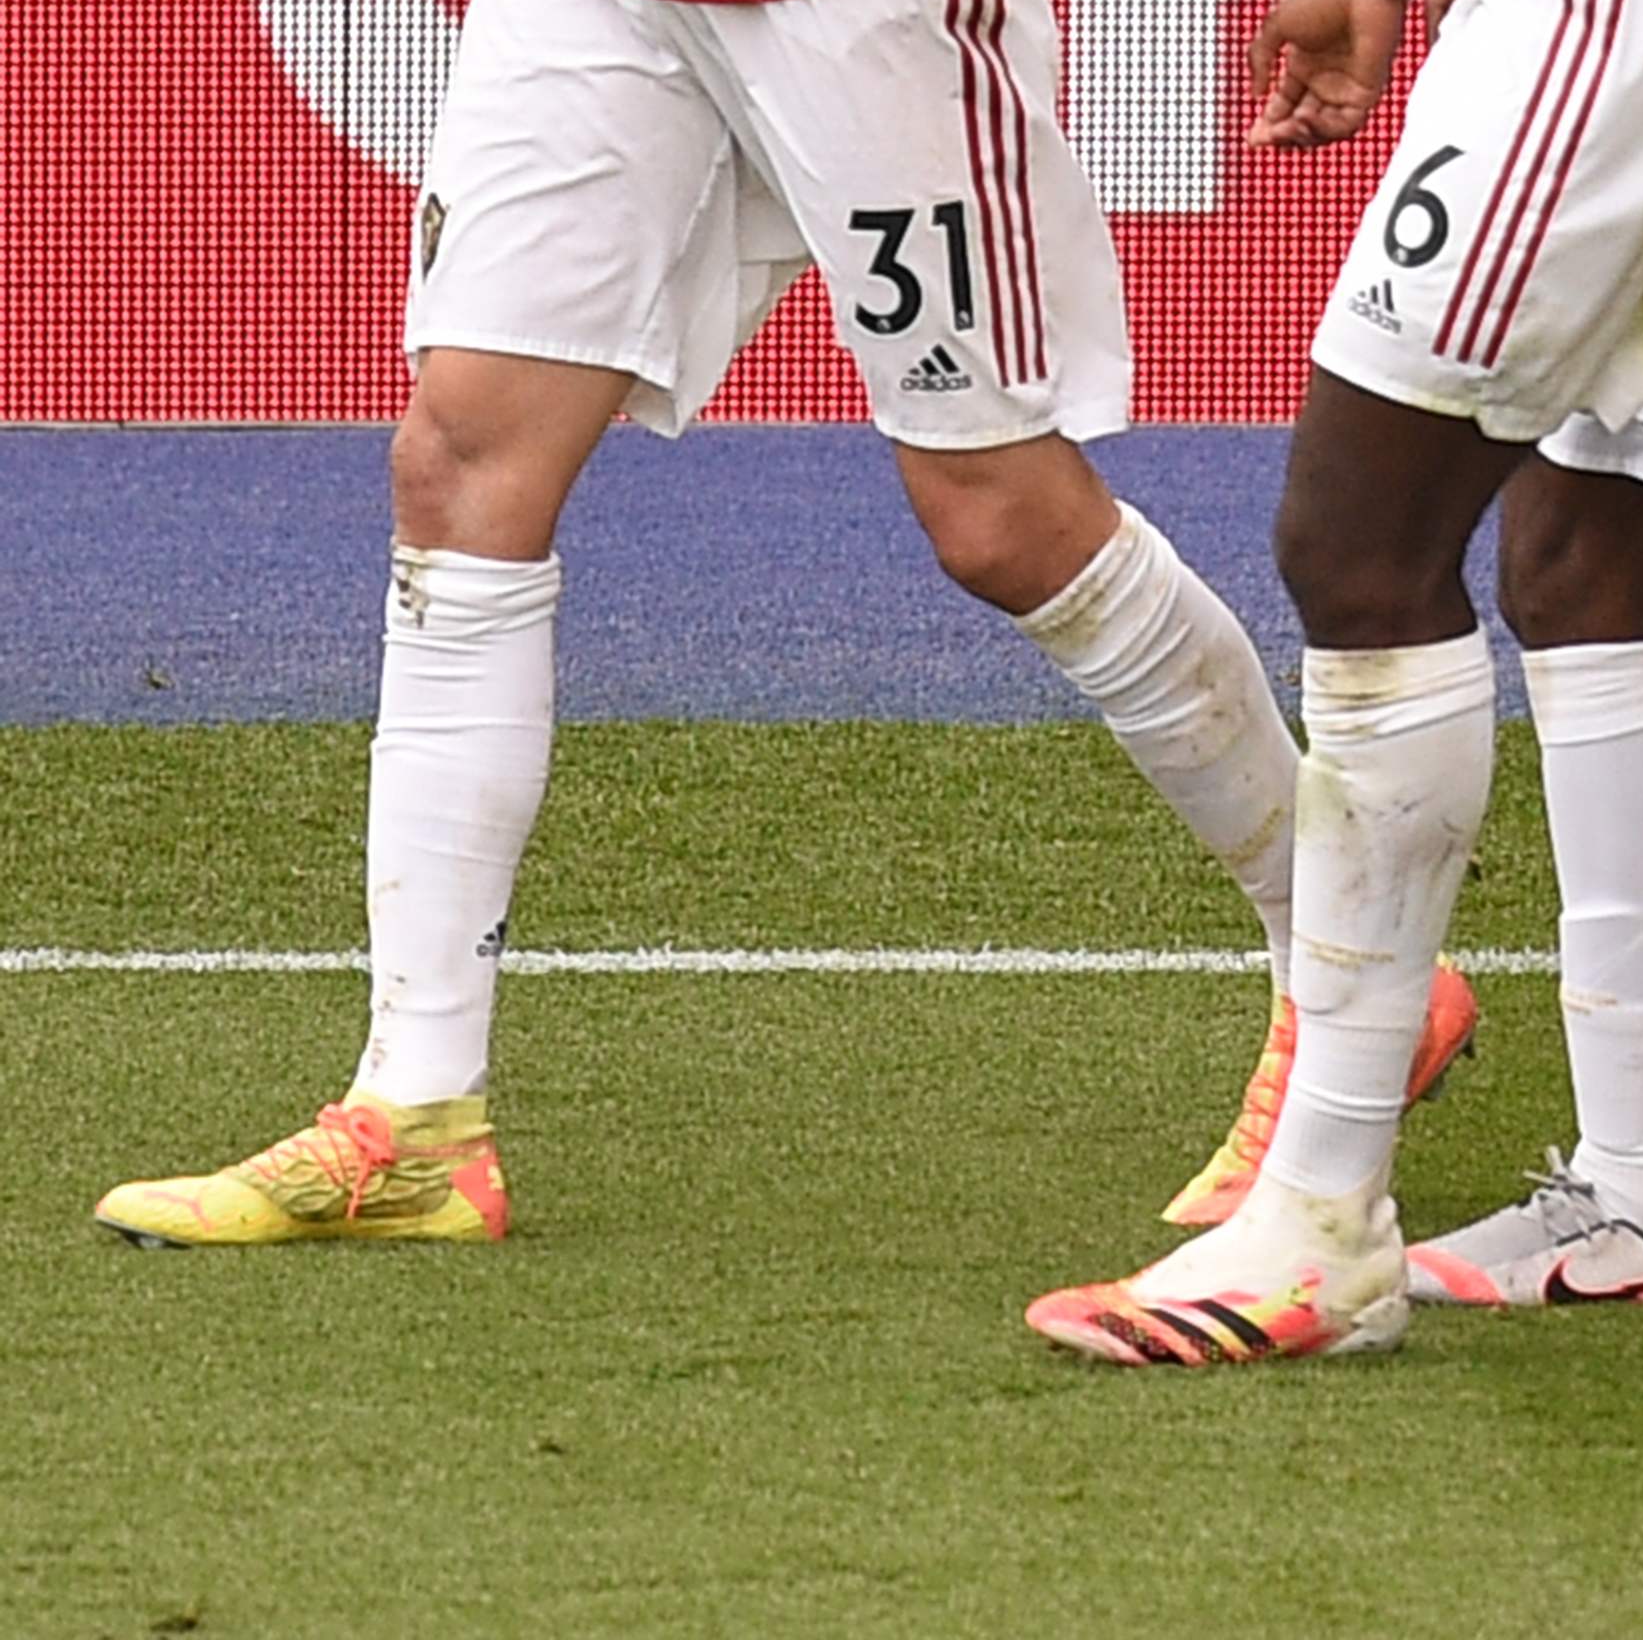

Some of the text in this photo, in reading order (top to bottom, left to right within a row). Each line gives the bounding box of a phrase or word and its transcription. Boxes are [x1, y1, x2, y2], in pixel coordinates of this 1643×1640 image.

[849, 199, 974, 334] 31
[1384, 145, 1466, 268] 6
[901, 372, 972, 392] adidas
